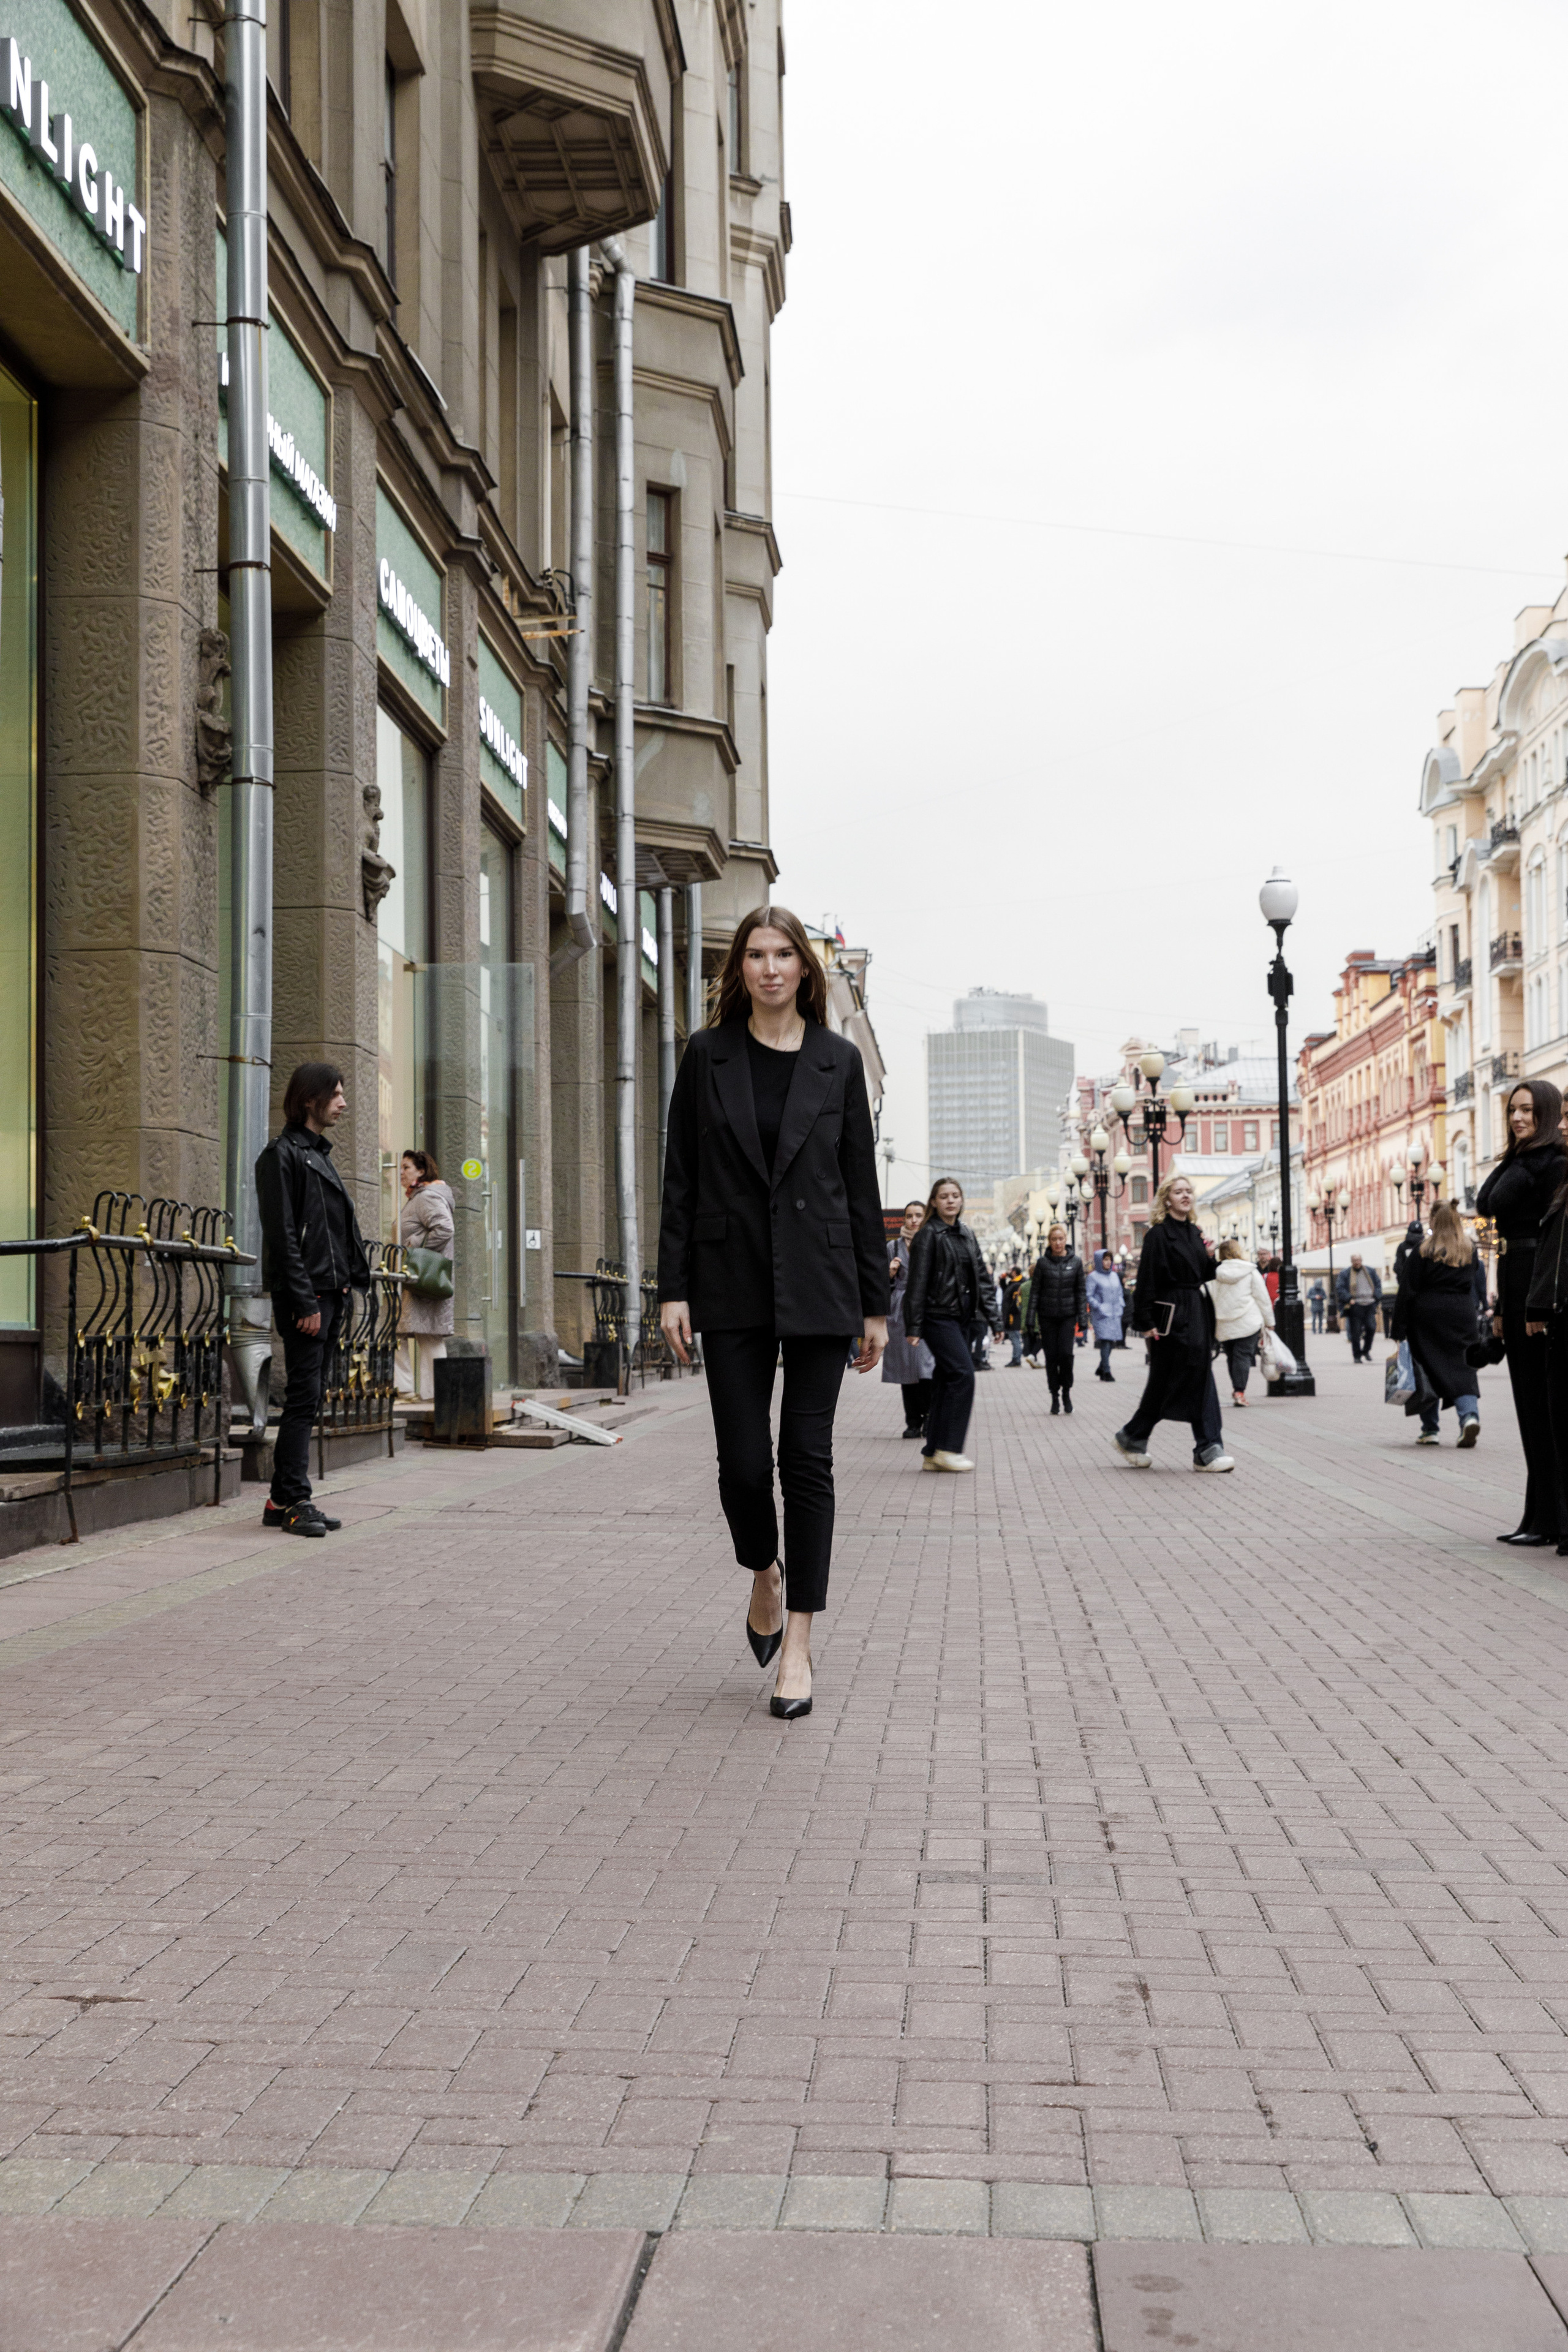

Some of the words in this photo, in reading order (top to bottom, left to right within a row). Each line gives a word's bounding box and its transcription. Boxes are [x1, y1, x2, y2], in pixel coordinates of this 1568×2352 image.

[295, 451, 336, 532] МАГАЗИН
[380, 558, 450, 688] САМОЦВЕТЫ
[479, 696, 528, 790] SUNLIGHT
